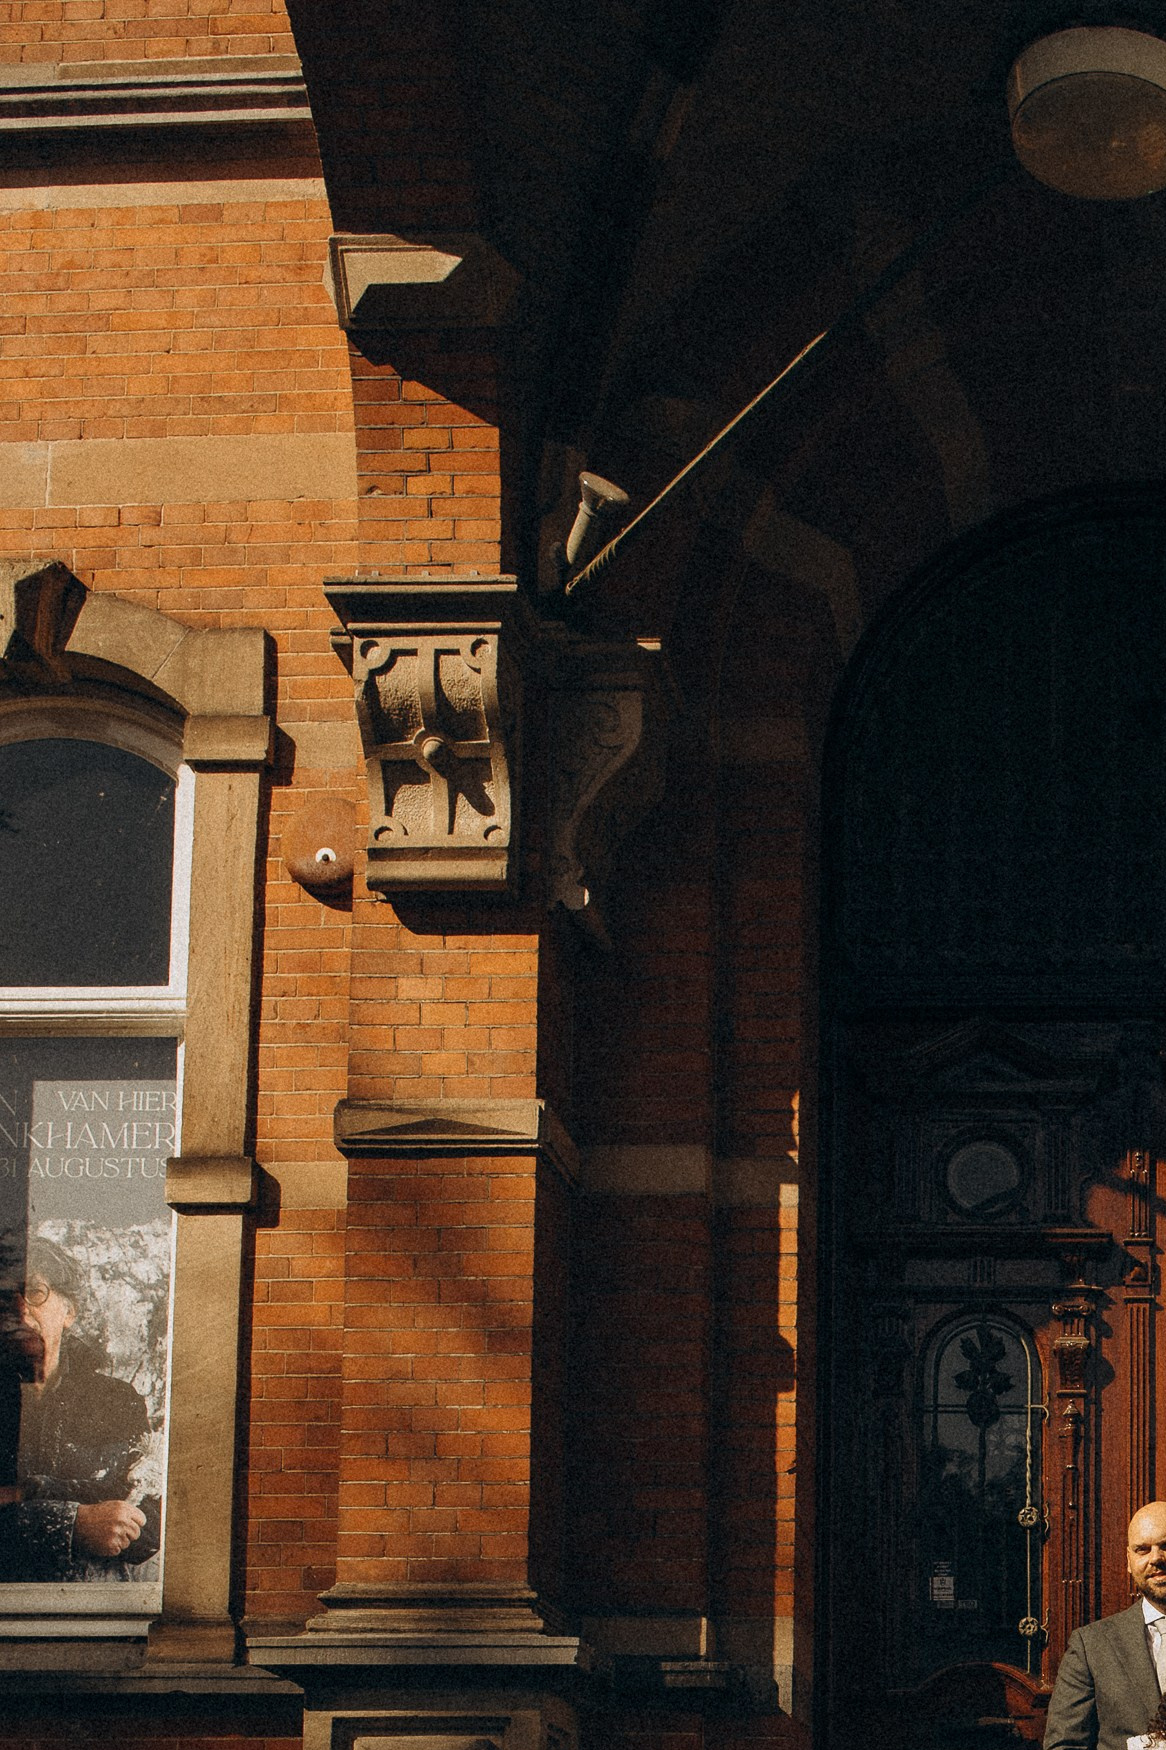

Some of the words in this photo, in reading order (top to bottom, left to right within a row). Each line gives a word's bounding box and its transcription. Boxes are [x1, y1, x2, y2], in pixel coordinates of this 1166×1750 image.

[57, 1090, 109, 1111] VAN
[117, 1090, 177, 1111] HIER
[0, 1121, 176, 1149] NKHAMER
